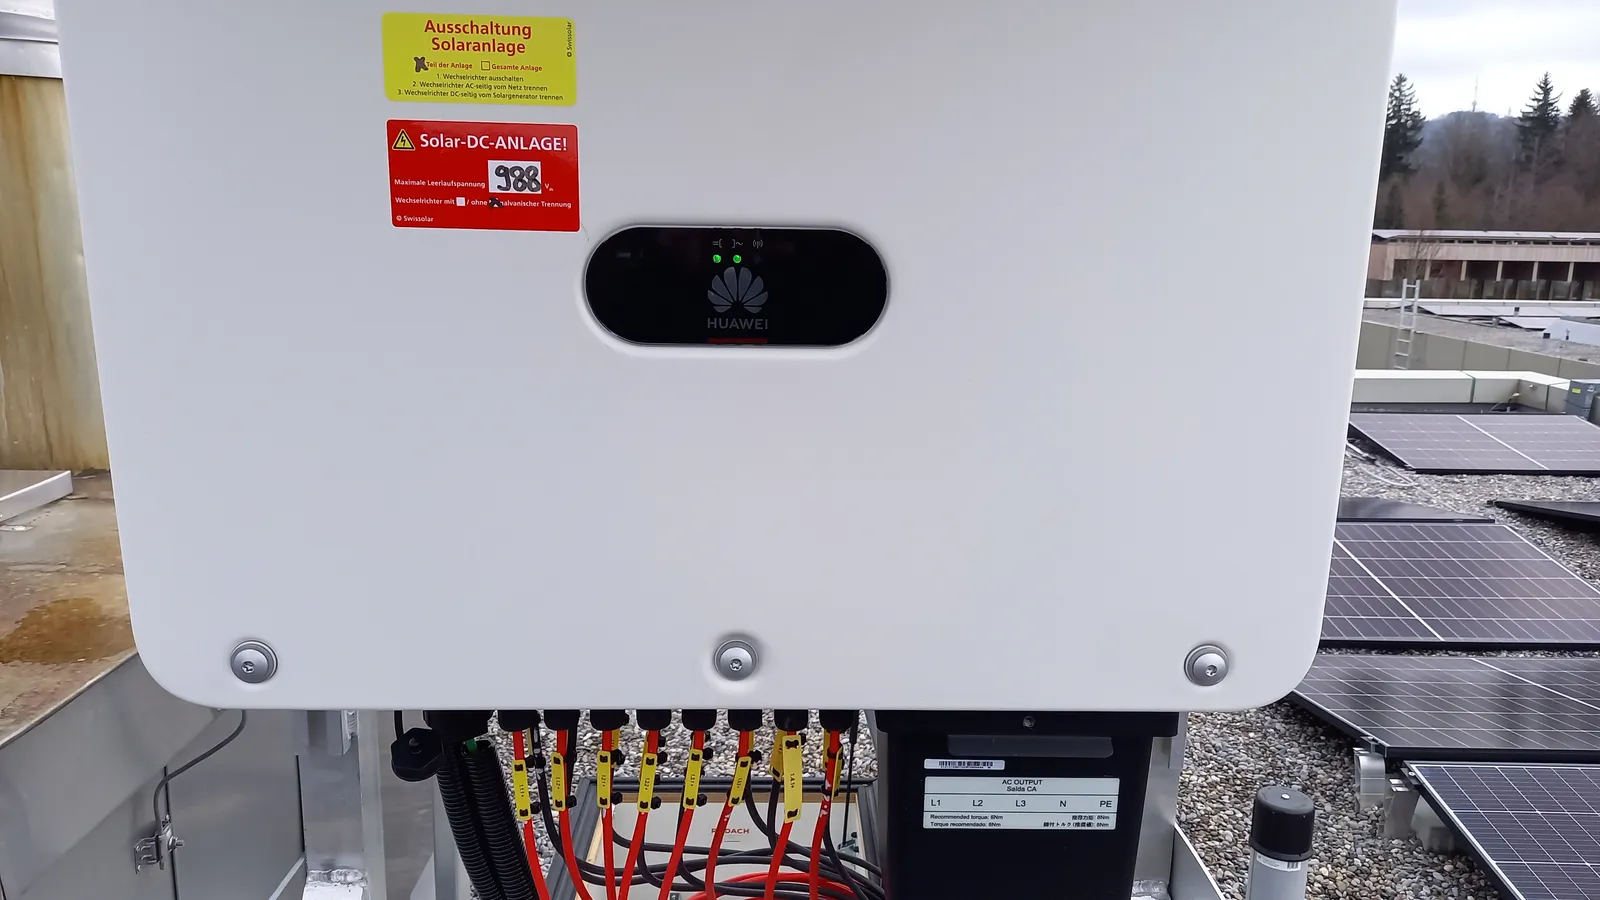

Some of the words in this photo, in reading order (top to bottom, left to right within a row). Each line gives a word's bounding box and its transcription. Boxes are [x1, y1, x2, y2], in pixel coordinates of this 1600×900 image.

[424, 19, 532, 39] Ausschaltung
[431, 37, 526, 56] Solaranlage
[520, 64, 542, 72] Anlage
[450, 91, 477, 99] DC-seitig
[493, 92, 538, 100] Solargenerator
[420, 134, 567, 151] Solar-DC-ANLAGE!
[428, 180, 485, 188] Leerlaufspannung
[495, 165, 541, 192] 988
[541, 201, 571, 209] Trennung
[707, 317, 768, 330] HUAWEI
